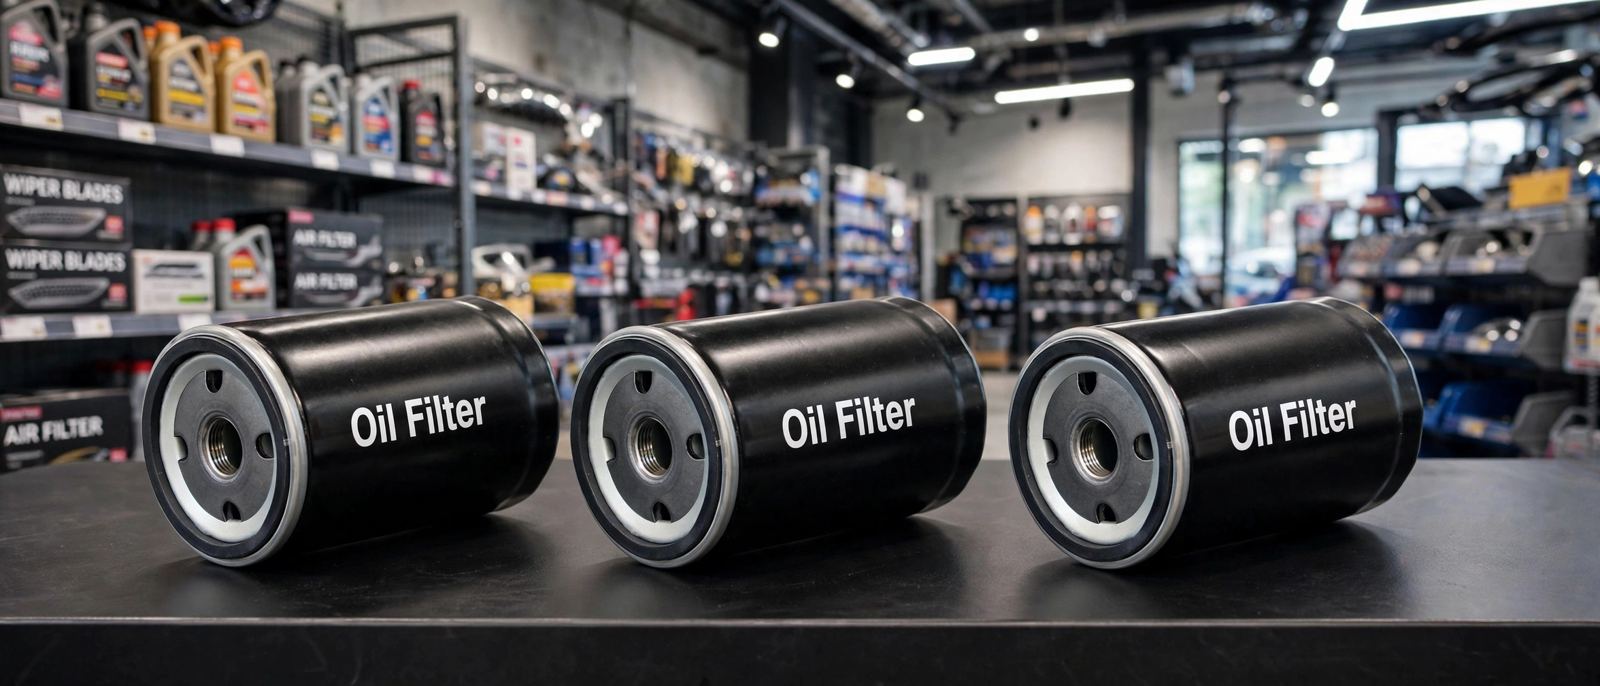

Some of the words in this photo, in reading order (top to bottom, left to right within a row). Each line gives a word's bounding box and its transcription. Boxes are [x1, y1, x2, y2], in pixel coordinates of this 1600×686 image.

[4, 172, 61, 198] WIPER
[62, 179, 124, 204] BLADES
[293, 228, 317, 247] AIR
[318, 230, 357, 249] FILTER
[5, 248, 64, 270] WIPER
[64, 250, 127, 273] BLADES
[294, 272, 318, 289] AIR
[319, 273, 358, 290] FILTER
[3, 422, 40, 447] AIR
[42, 415, 104, 442] FILTER
[351, 404, 396, 447] Oil
[405, 395, 486, 438] Filter
[782, 406, 827, 449] Oil
[835, 396, 916, 440] Filter
[1229, 408, 1272, 450] Oil
[1280, 399, 1357, 442] Filter
